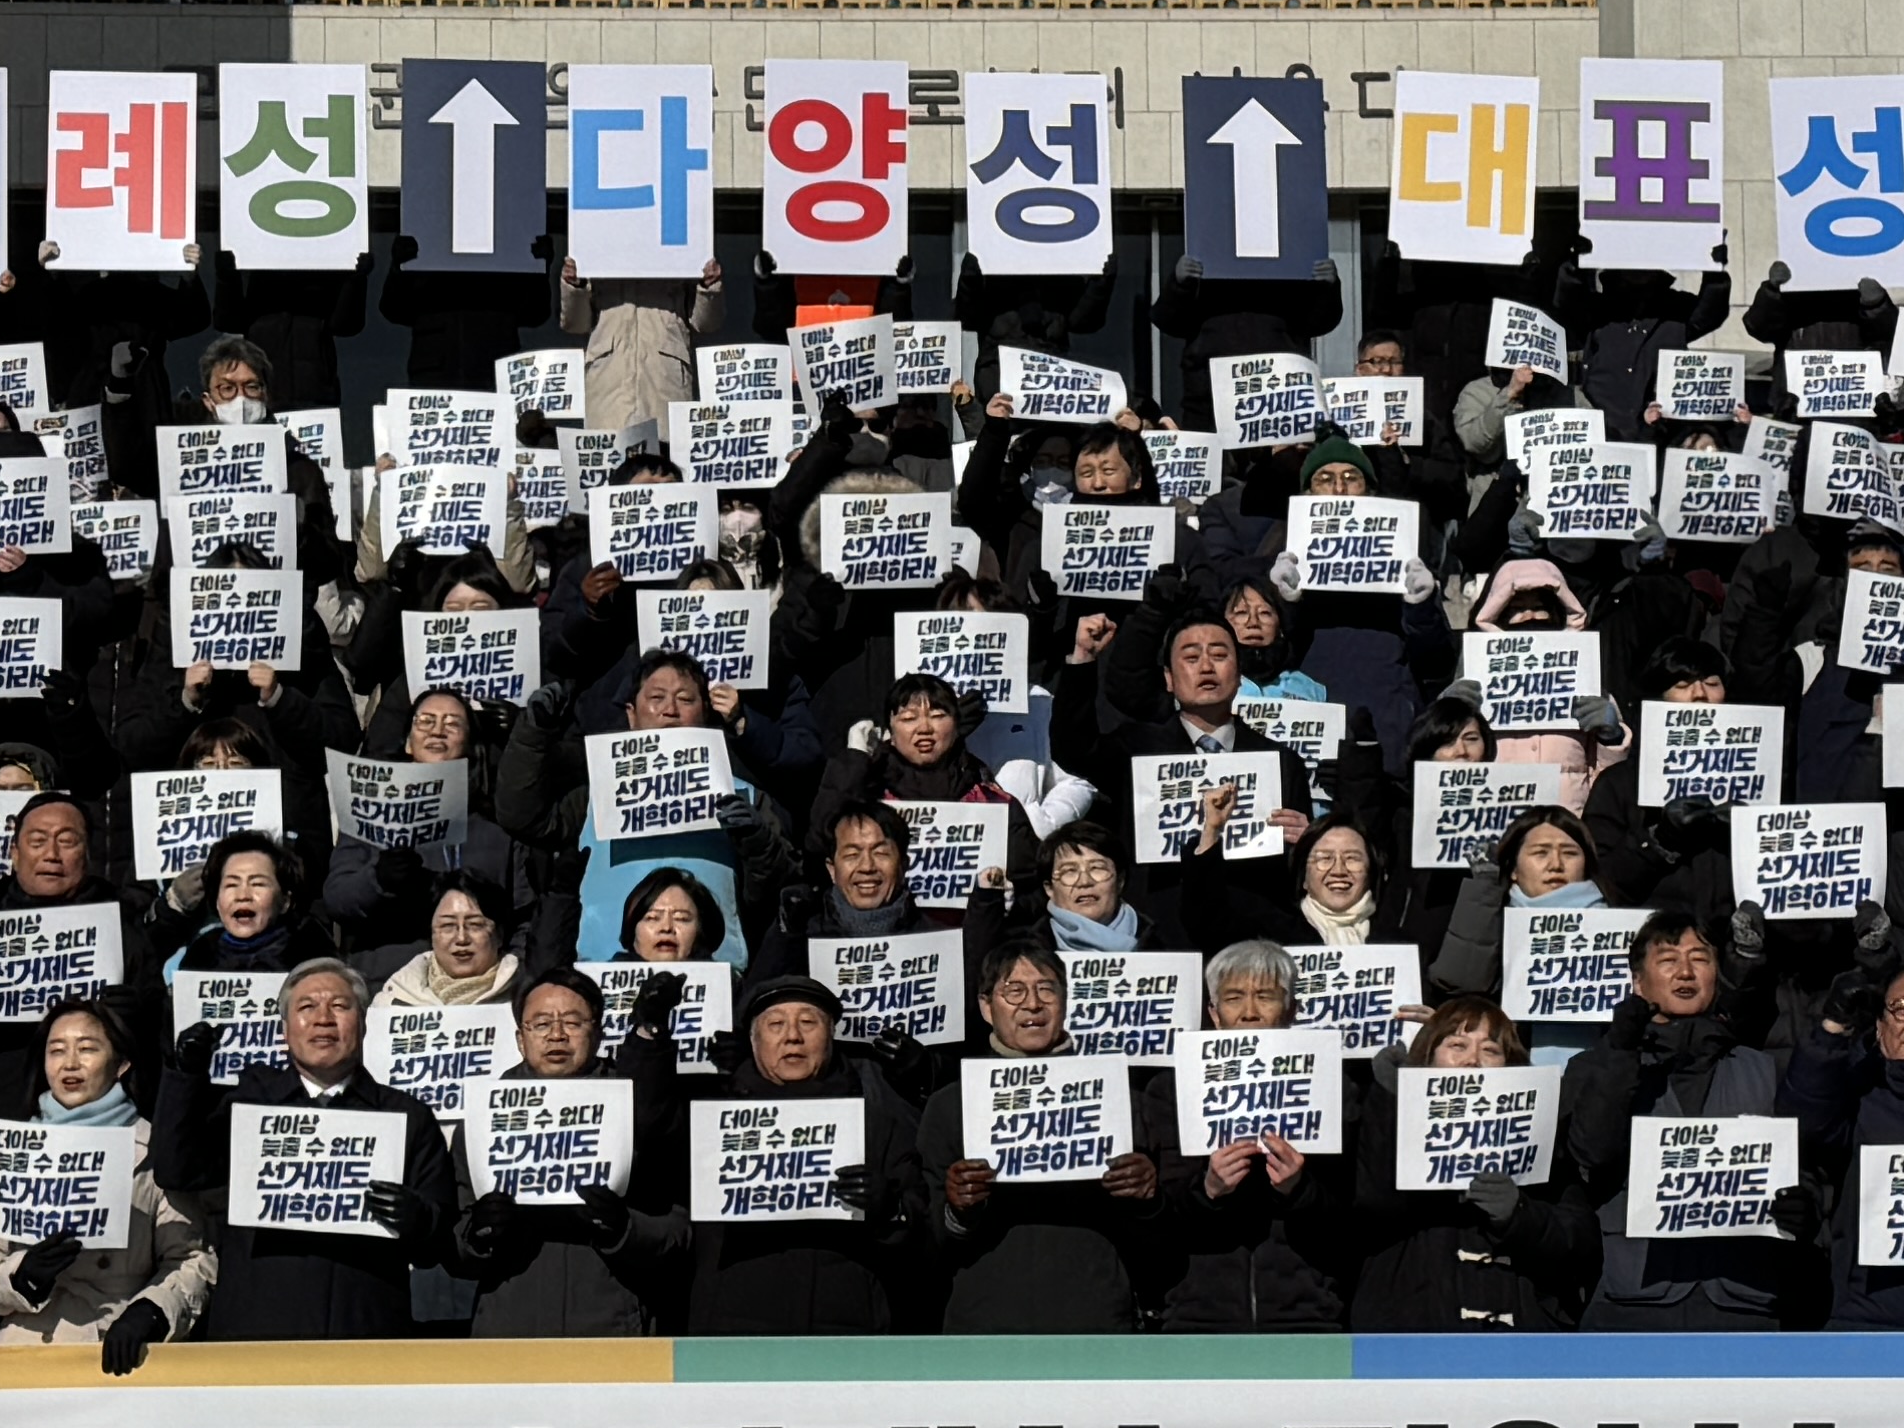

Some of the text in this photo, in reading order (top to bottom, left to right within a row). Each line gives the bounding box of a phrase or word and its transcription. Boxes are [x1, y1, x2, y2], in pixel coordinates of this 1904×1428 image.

[13, 475, 48, 495] 없다!
[842, 498, 887, 517] 더이상
[1309, 500, 1355, 517] 더이상
[844, 512, 931, 535] 늦출 수 없다!
[1311, 517, 1398, 534] 늦출 수 없다!
[842, 531, 928, 561] 선거제도
[1306, 535, 1394, 560] 선거제도
[841, 556, 934, 585] 개혁하라!
[1307, 560, 1399, 585] 개혁하라!
[190, 574, 237, 592] 더이상
[192, 590, 281, 611] 늦출 수 없다!
[1, 617, 39, 636] 없다!
[190, 610, 278, 637] 선거제도
[192, 636, 286, 662] 개혁하라!
[1757, 810, 1811, 832] 더이상
[1759, 825, 1863, 853] 늦출 수 없다!
[1757, 848, 1860, 884] 선거제도
[990, 1064, 1048, 1088] 더이상
[993, 1078, 1103, 1112] 늦출 수 없다!
[991, 1104, 1101, 1145] 선거제도
